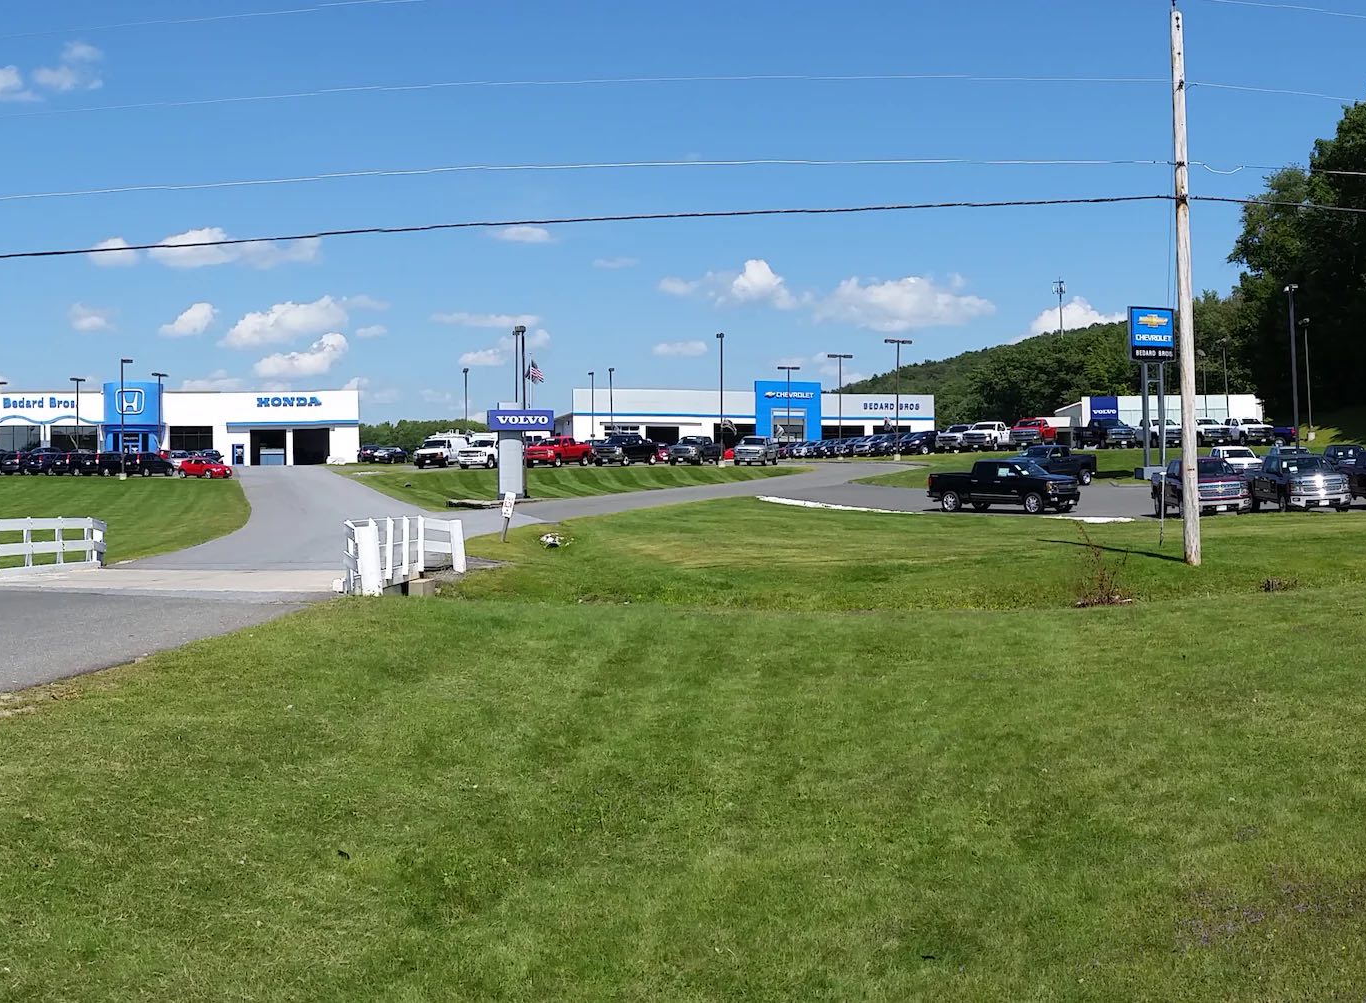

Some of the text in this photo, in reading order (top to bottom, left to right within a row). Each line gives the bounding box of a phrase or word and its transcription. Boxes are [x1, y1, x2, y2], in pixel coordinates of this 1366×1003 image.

[1135, 334, 1172, 342] CHEVROLET
[1135, 349, 1156, 357] BEDARD
[776, 391, 814, 399] CHEVROLET
[3, 397, 44, 409] Bedard
[256, 396, 322, 407] HONDA
[863, 402, 920, 411] BEDARD BROS
[496, 415, 549, 425] VOLVO
